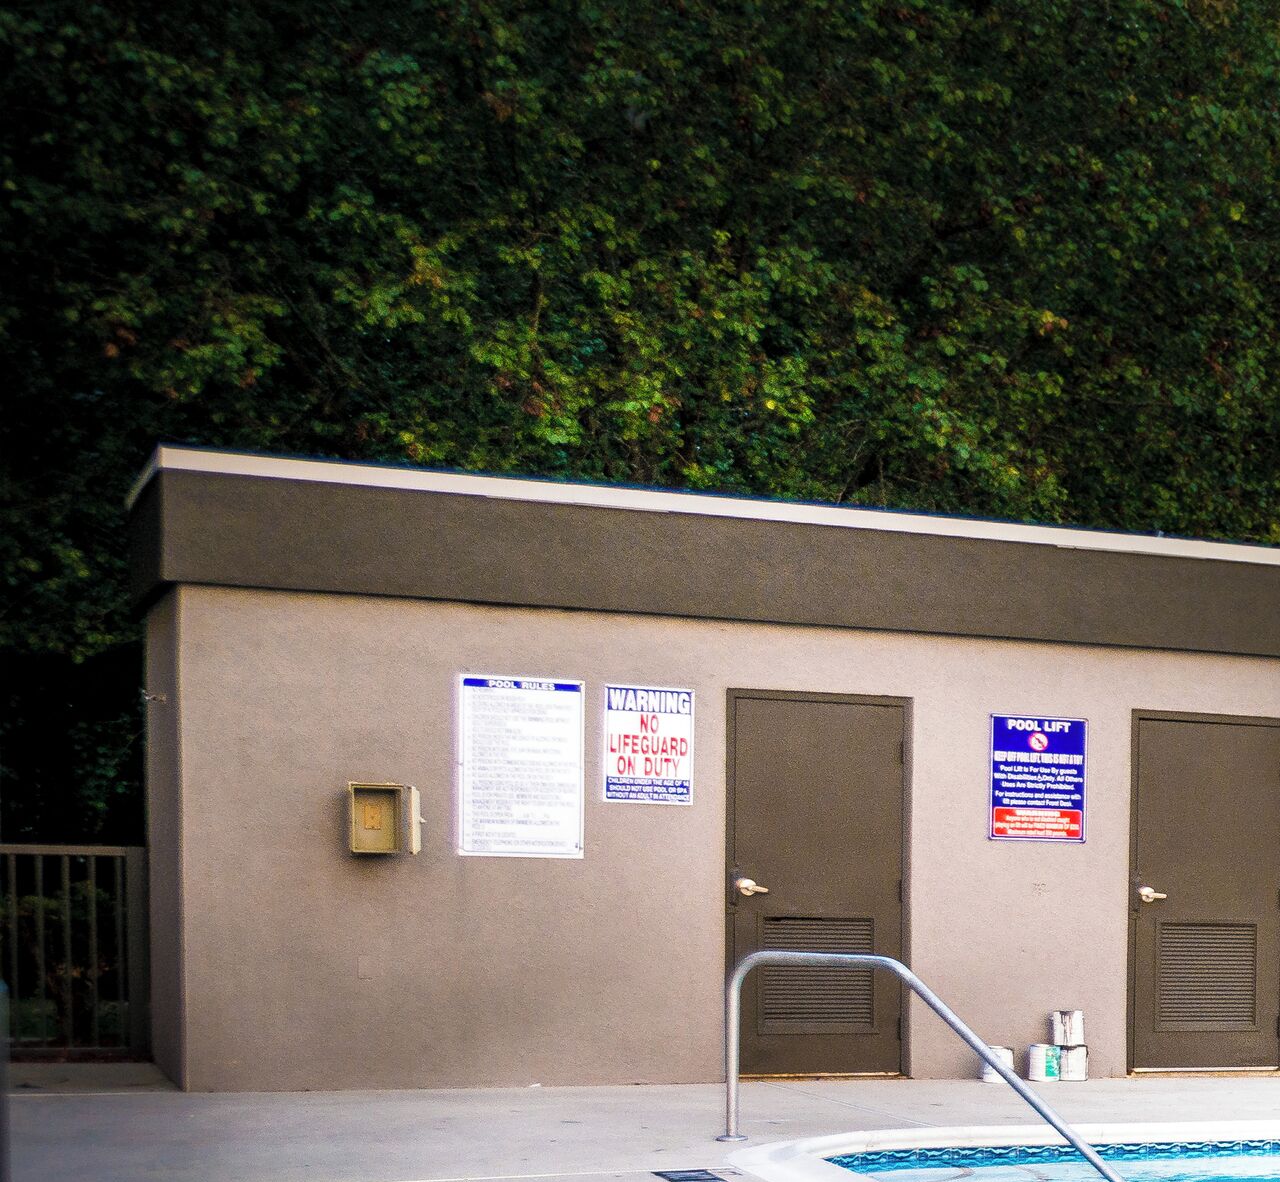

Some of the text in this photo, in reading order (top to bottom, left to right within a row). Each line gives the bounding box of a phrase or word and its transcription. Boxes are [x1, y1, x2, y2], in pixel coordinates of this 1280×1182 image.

[489, 680, 555, 690] POOL RULES
[609, 688, 690, 714] WARNING
[640, 714, 658, 733] NO
[1007, 719, 1071, 732] POOL LIFT
[610, 734, 688, 756] LIFEGUARD
[617, 756, 680, 777] ON DUTY
